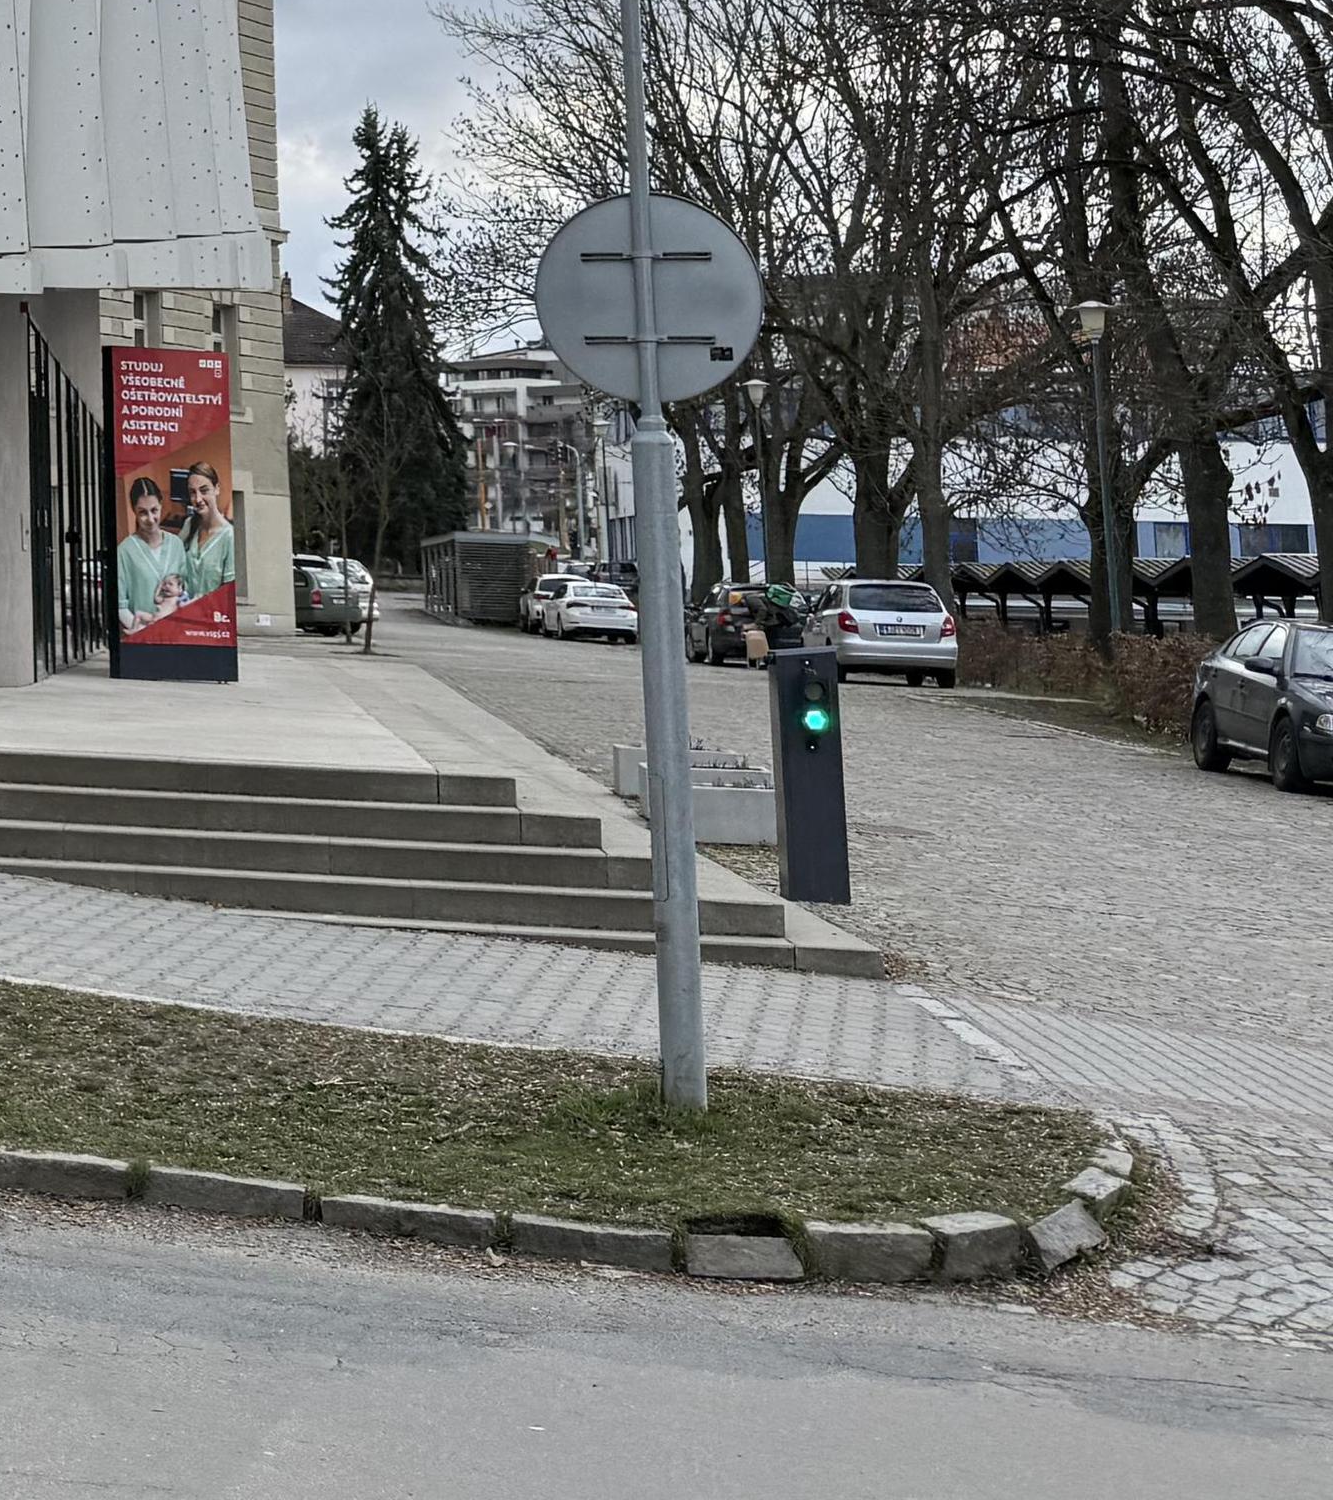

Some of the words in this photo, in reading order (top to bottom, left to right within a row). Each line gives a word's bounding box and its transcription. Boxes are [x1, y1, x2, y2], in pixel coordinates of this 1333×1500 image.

[120, 360, 163, 372] STUDUJ
[121, 387, 222, 405] OŠETŘOVATELSTVÍ
[121, 404, 130, 415] A
[131, 405, 183, 418] PORODNÍ
[122, 419, 178, 432] ASISTENCI
[122, 434, 139, 445] NA
[139, 433, 165, 446] VŠPJ
